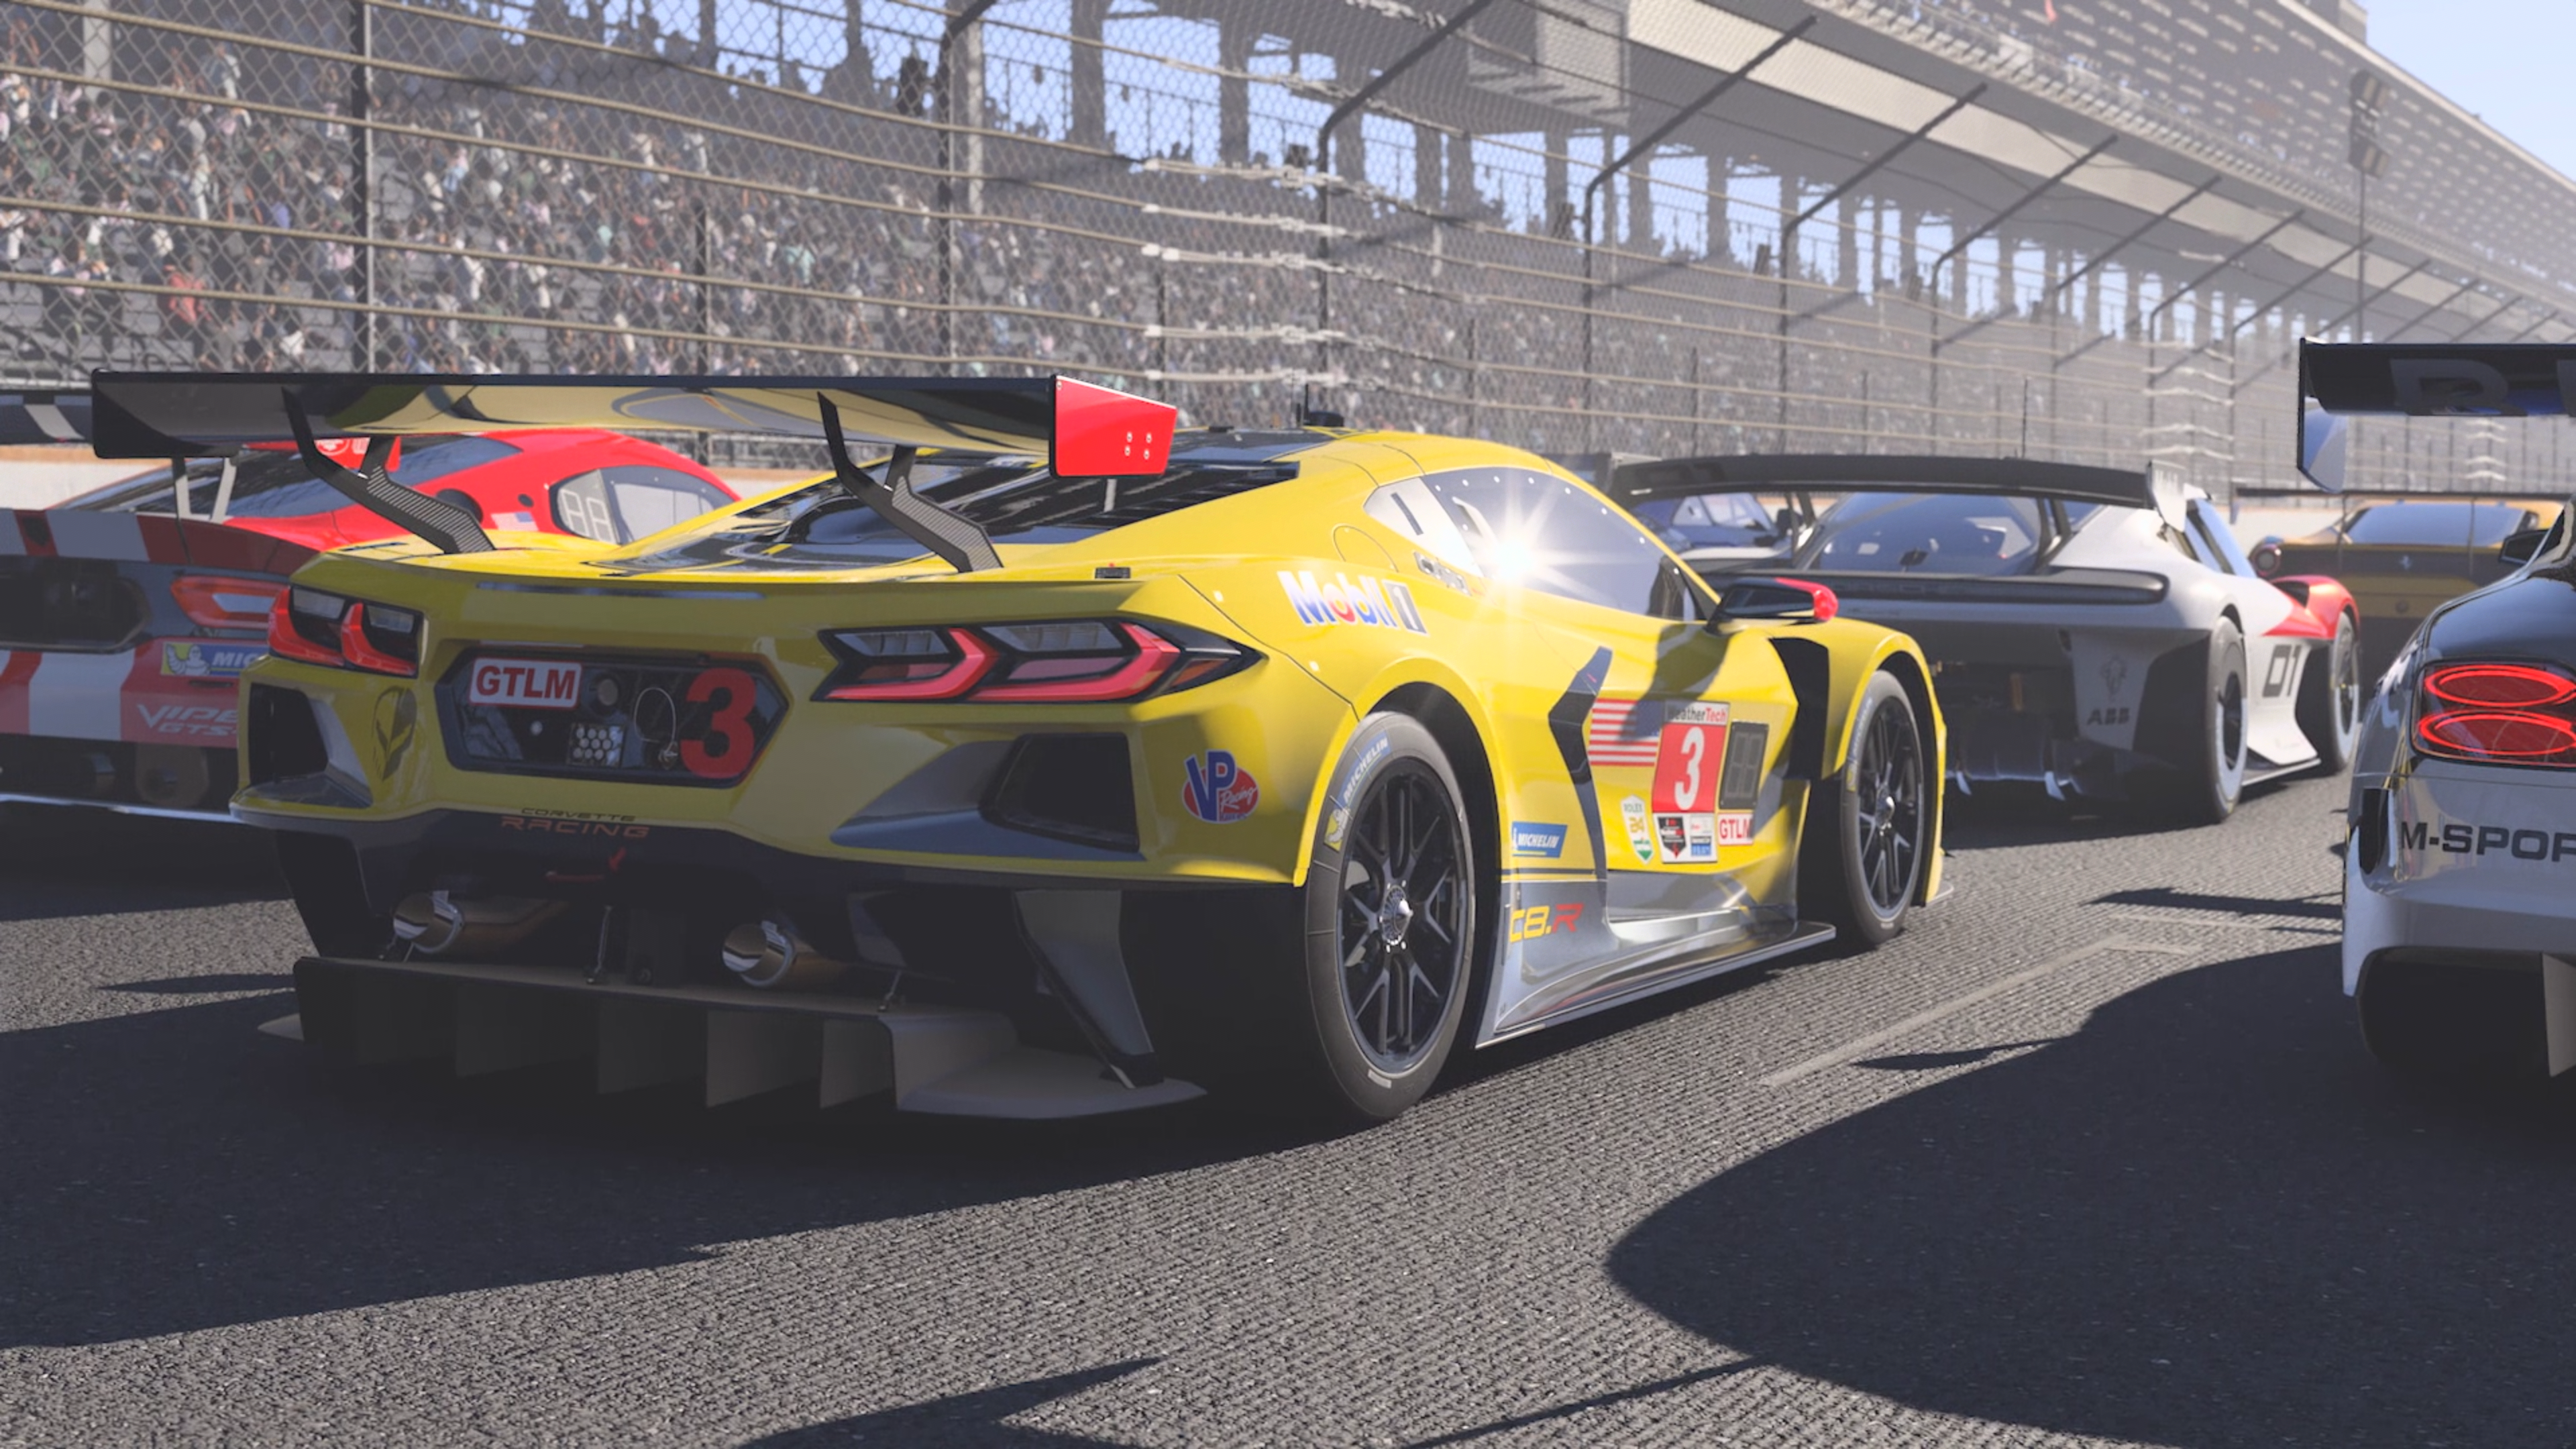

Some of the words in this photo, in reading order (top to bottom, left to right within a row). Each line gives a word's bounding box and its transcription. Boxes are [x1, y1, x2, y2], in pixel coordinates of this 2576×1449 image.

[1277, 571, 1400, 629] Mobil
[476, 665, 576, 700] GTLM
[2262, 645, 2302, 697] 01
[137, 704, 238, 729] VIPE
[680, 667, 757, 779] 3
[2086, 708, 2130, 725] ABB
[1185, 751, 1236, 822] VP
[1674, 727, 1705, 810] 3
[501, 816, 650, 838] RACING
[521, 807, 637, 822] CORVETTE
[2401, 822, 2576, 862] M-SPOR
